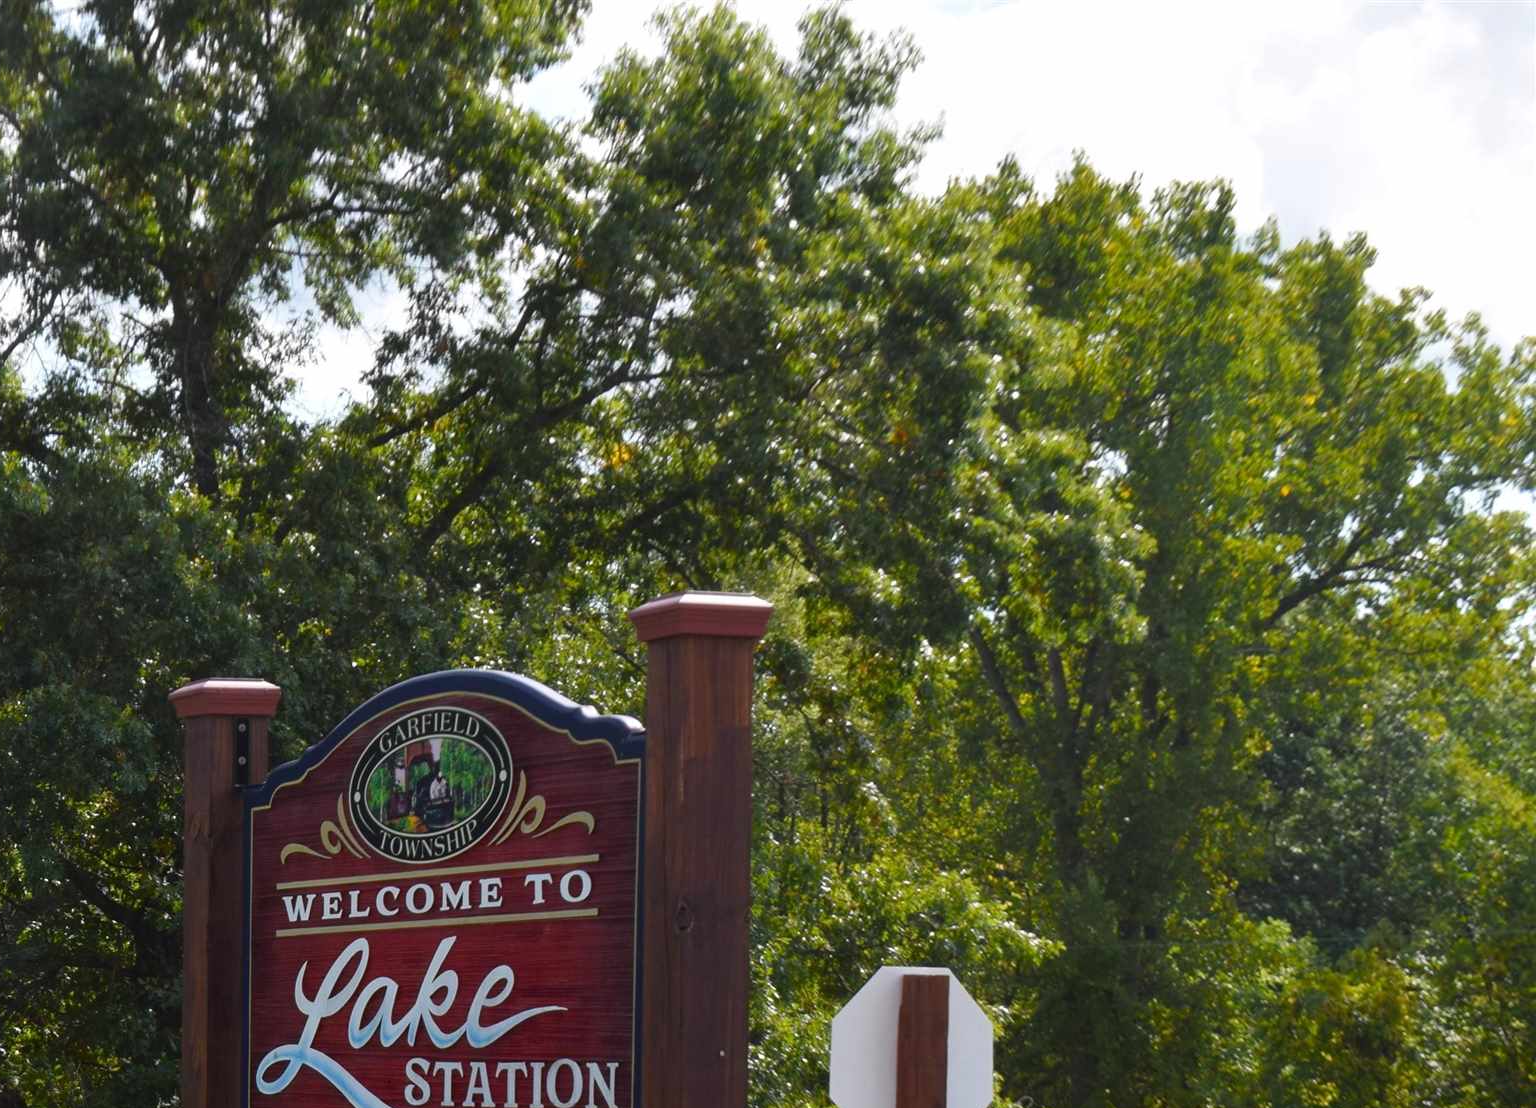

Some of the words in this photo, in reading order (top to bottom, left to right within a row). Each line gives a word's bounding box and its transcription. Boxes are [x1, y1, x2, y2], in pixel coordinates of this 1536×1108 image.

[379, 712, 480, 753] GARFIELD
[380, 819, 478, 859] TOWNSHIP
[282, 878, 503, 923] WELCOME
[524, 870, 593, 904] TO
